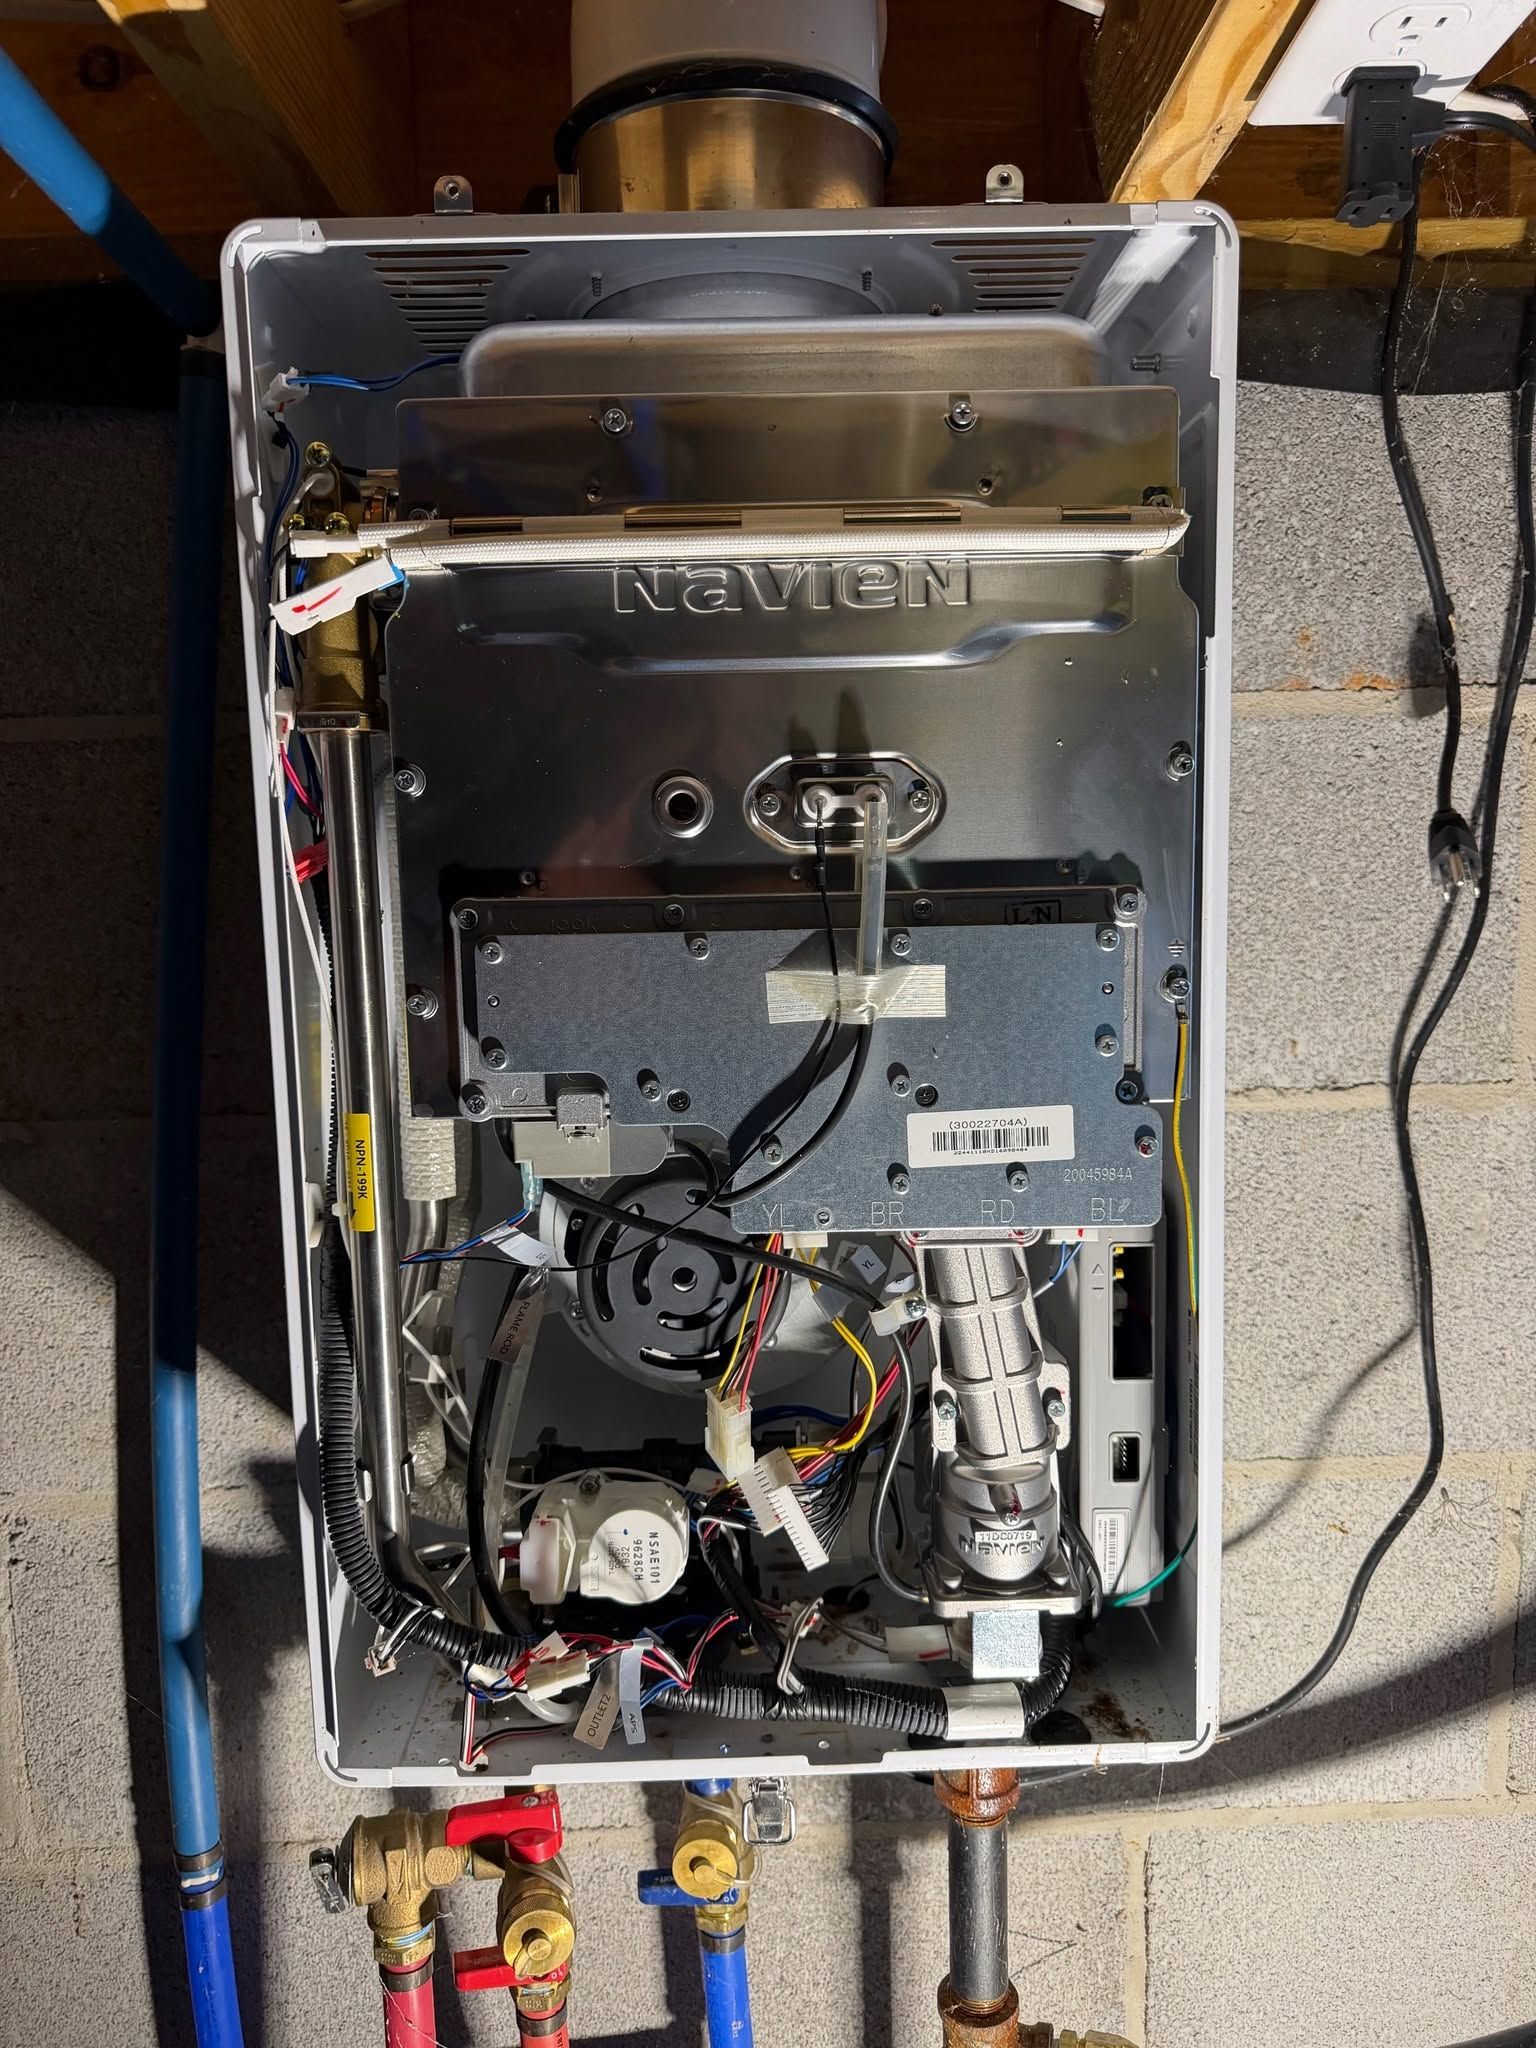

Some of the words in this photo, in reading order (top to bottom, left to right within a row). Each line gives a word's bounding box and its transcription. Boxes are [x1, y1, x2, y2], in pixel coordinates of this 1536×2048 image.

[948, 1117, 1028, 1130] (30022704A)
[355, 1139, 368, 1200] NPN-199K
[1063, 1168, 1133, 1182] 20045984A
[762, 1203, 794, 1227] YL
[871, 1202, 904, 1226] BR
[981, 1199, 1015, 1224] RD
[861, 1258, 875, 1270] YL
[509, 1300, 530, 1333] FLAME
[499, 1333, 514, 1355] ROD
[633, 1538, 644, 1581] 9628CH
[649, 1531, 661, 1584] NSAE101
[587, 1693, 612, 1737] OUTLET2
[628, 1712, 638, 1734] APS
